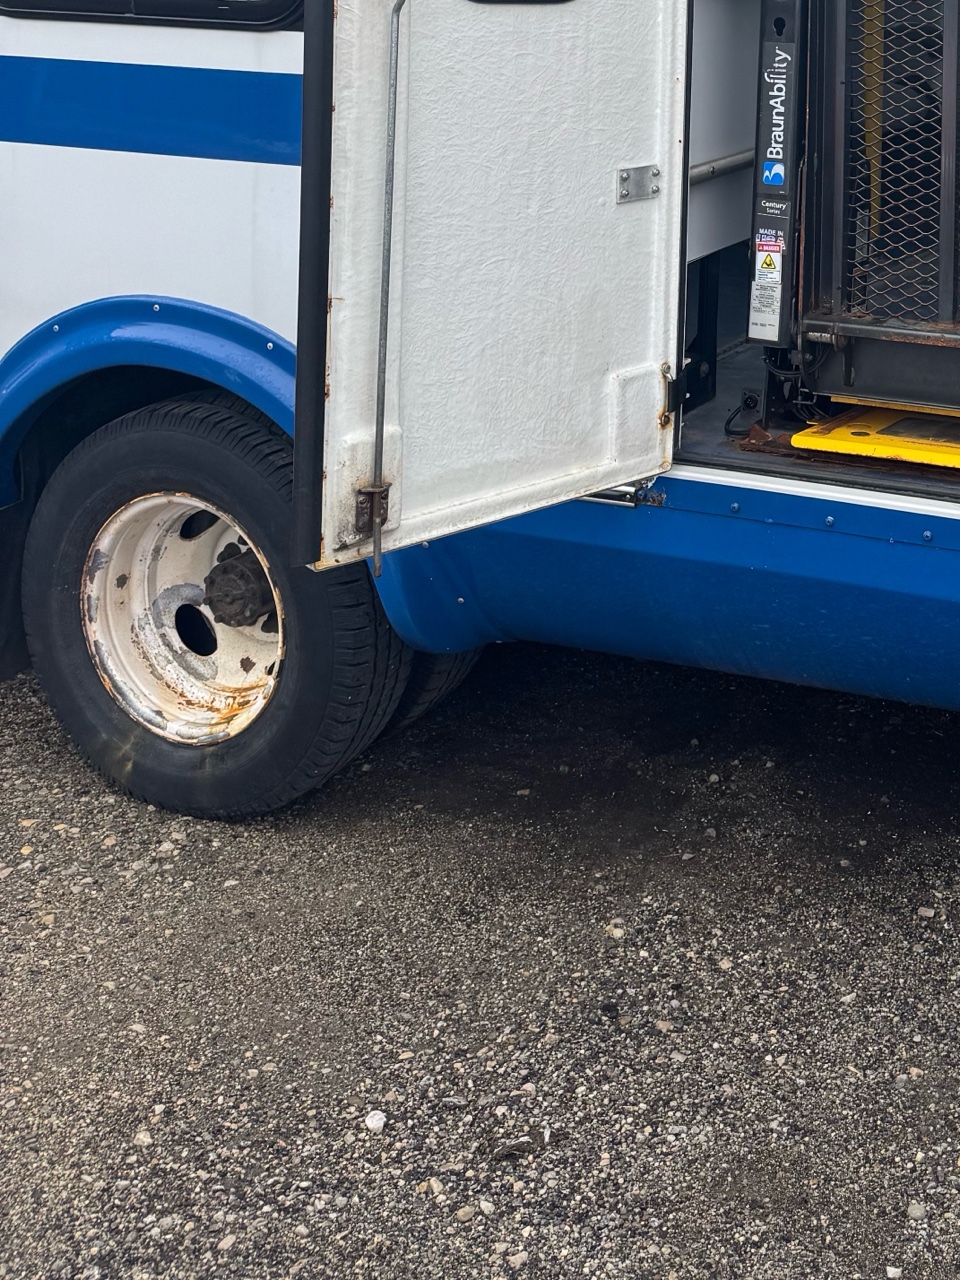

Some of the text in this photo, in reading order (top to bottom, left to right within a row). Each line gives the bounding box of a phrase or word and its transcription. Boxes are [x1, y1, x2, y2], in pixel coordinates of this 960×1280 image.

[764, 47, 792, 160] BraunAbility
[761, 200, 787, 211] Century
[759, 228, 777, 236] MADE
